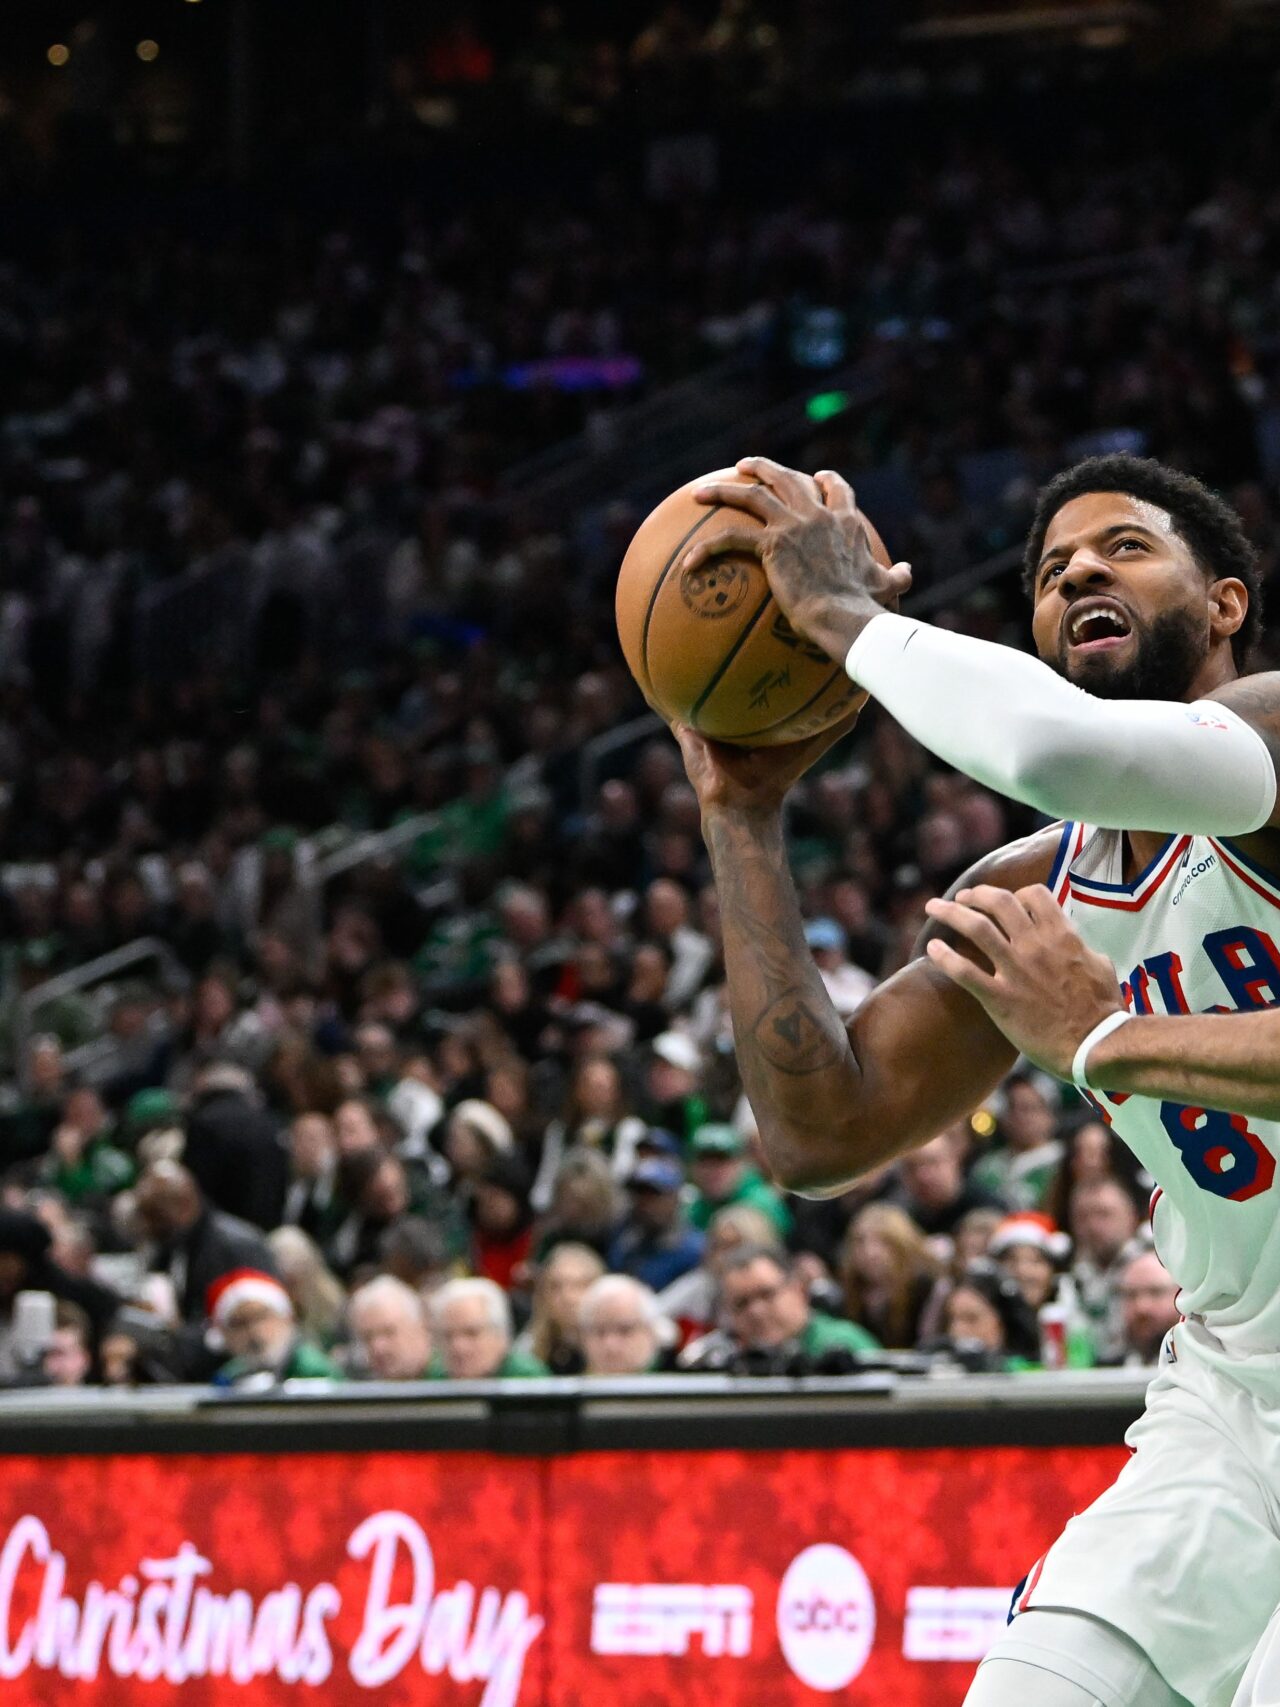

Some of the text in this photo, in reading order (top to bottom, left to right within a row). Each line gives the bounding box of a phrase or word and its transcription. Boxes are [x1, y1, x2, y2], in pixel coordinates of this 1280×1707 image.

[1160, 1100, 1277, 1203] 8
[0, 1510, 545, 1707] Christmas Day
[591, 1583, 753, 1657] ESPN
